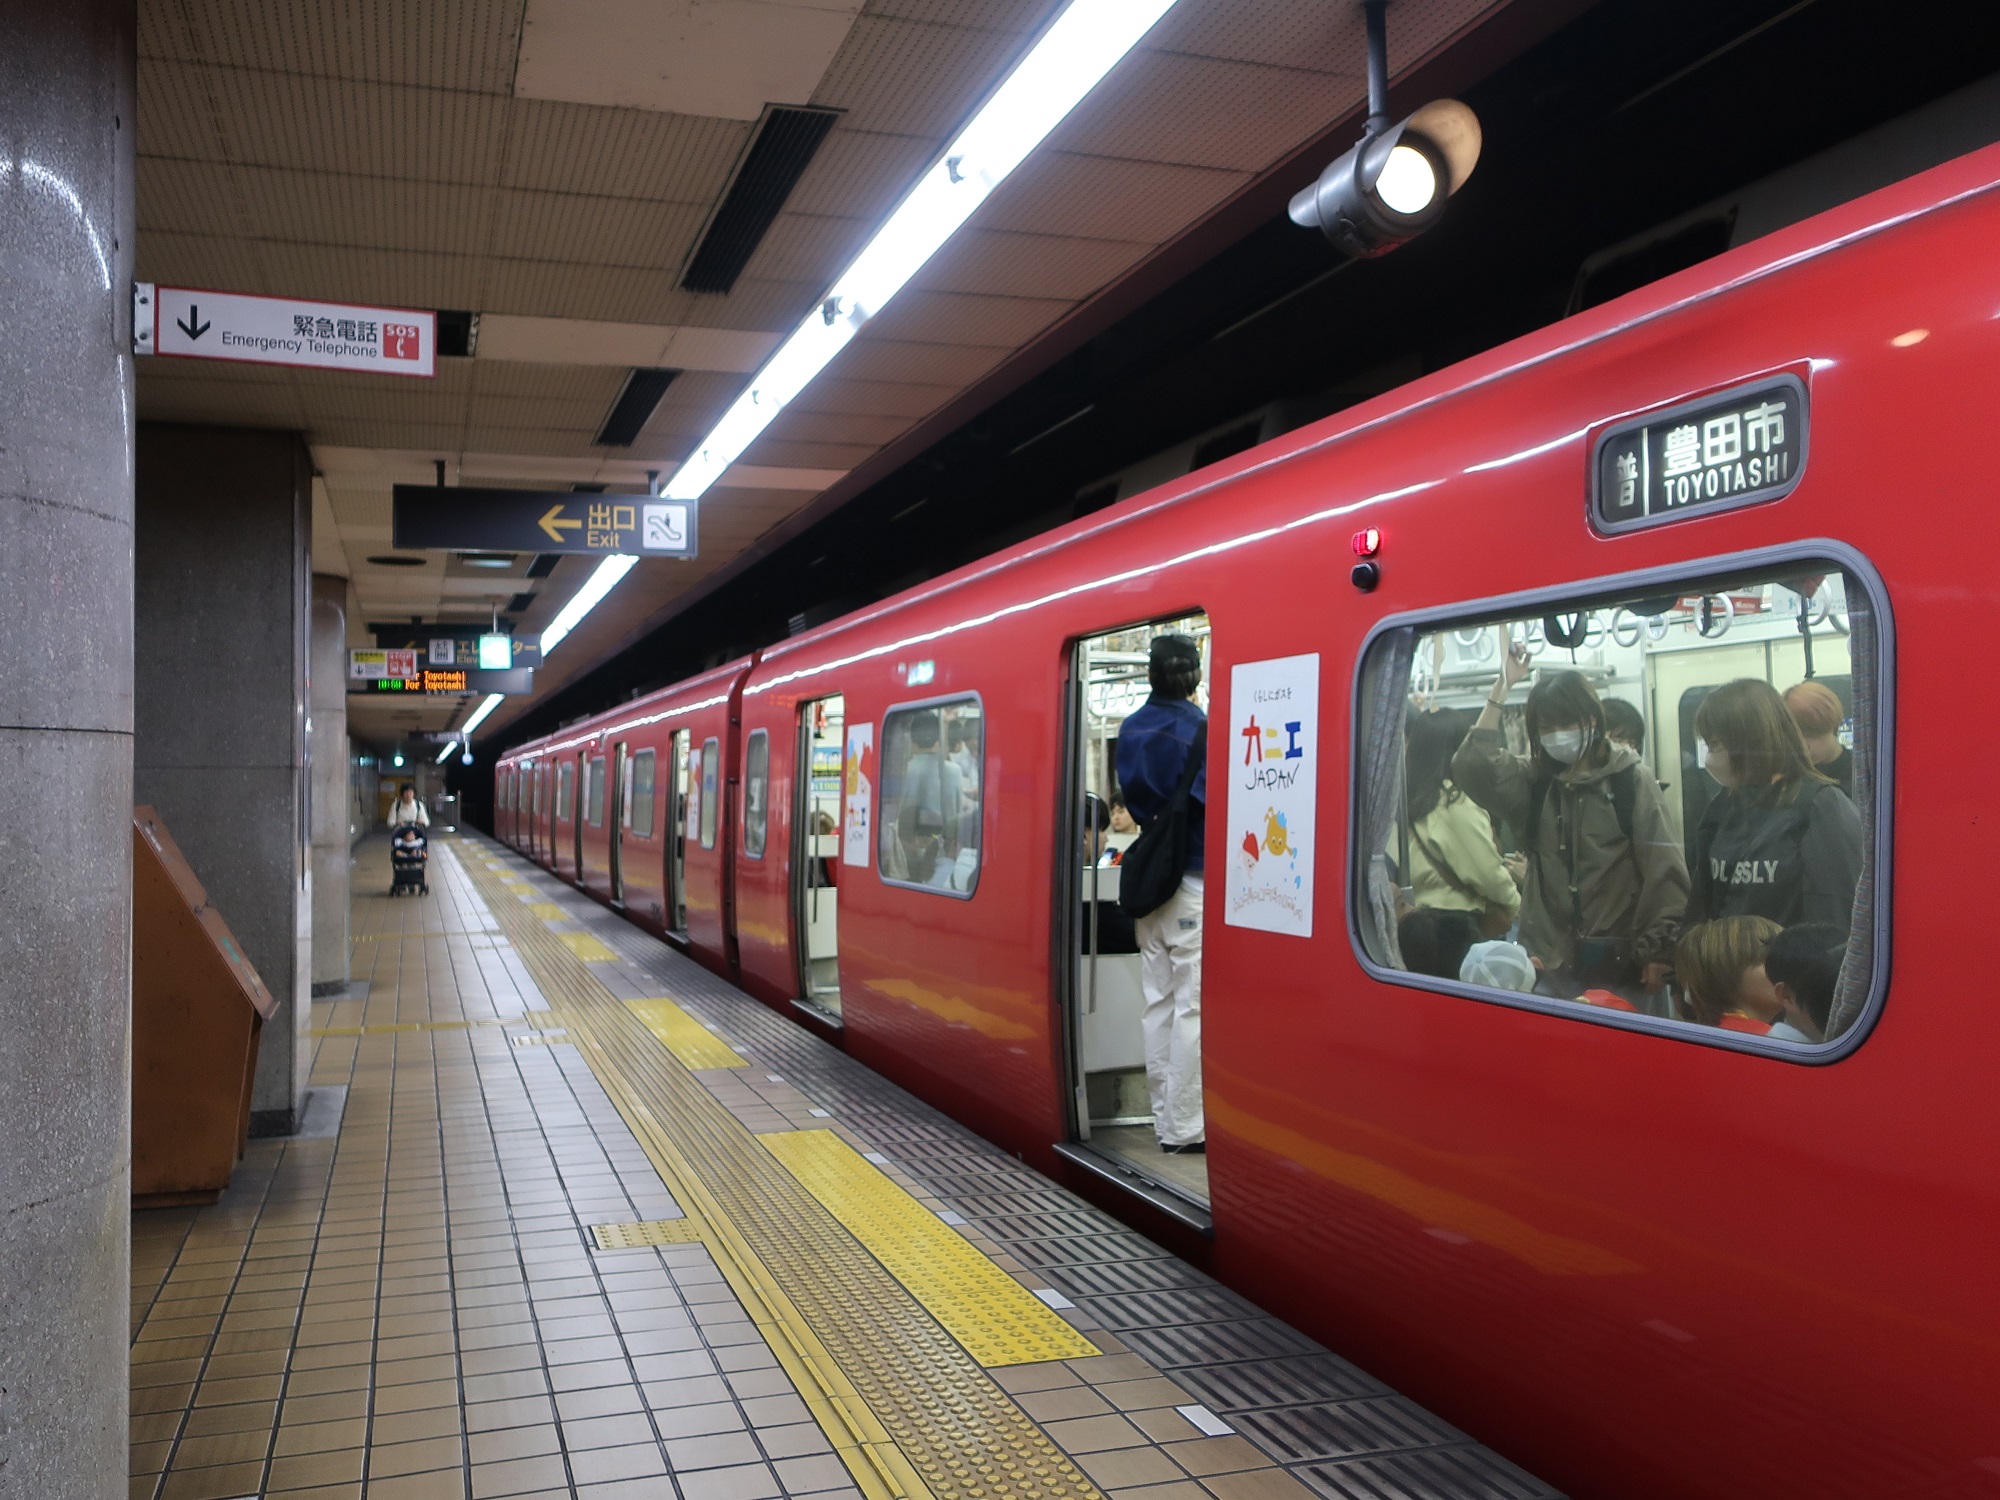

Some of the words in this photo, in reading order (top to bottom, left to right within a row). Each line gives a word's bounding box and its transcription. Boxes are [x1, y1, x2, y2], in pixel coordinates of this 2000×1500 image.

[293, 315, 378, 343] 緊急電話
[386, 324, 416, 338] SOS
[221, 331, 302, 354] Emergency
[307, 339, 378, 359] Telephone
[1663, 401, 1787, 477] 豊田市
[1663, 451, 1788, 507] TOYOTASHI
[588, 502, 636, 531] 出口
[587, 530, 620, 548] Exit
[405, 679, 421, 690] For
[1242, 714, 1303, 767] カニエ
[1245, 763, 1300, 791] JAPAN
